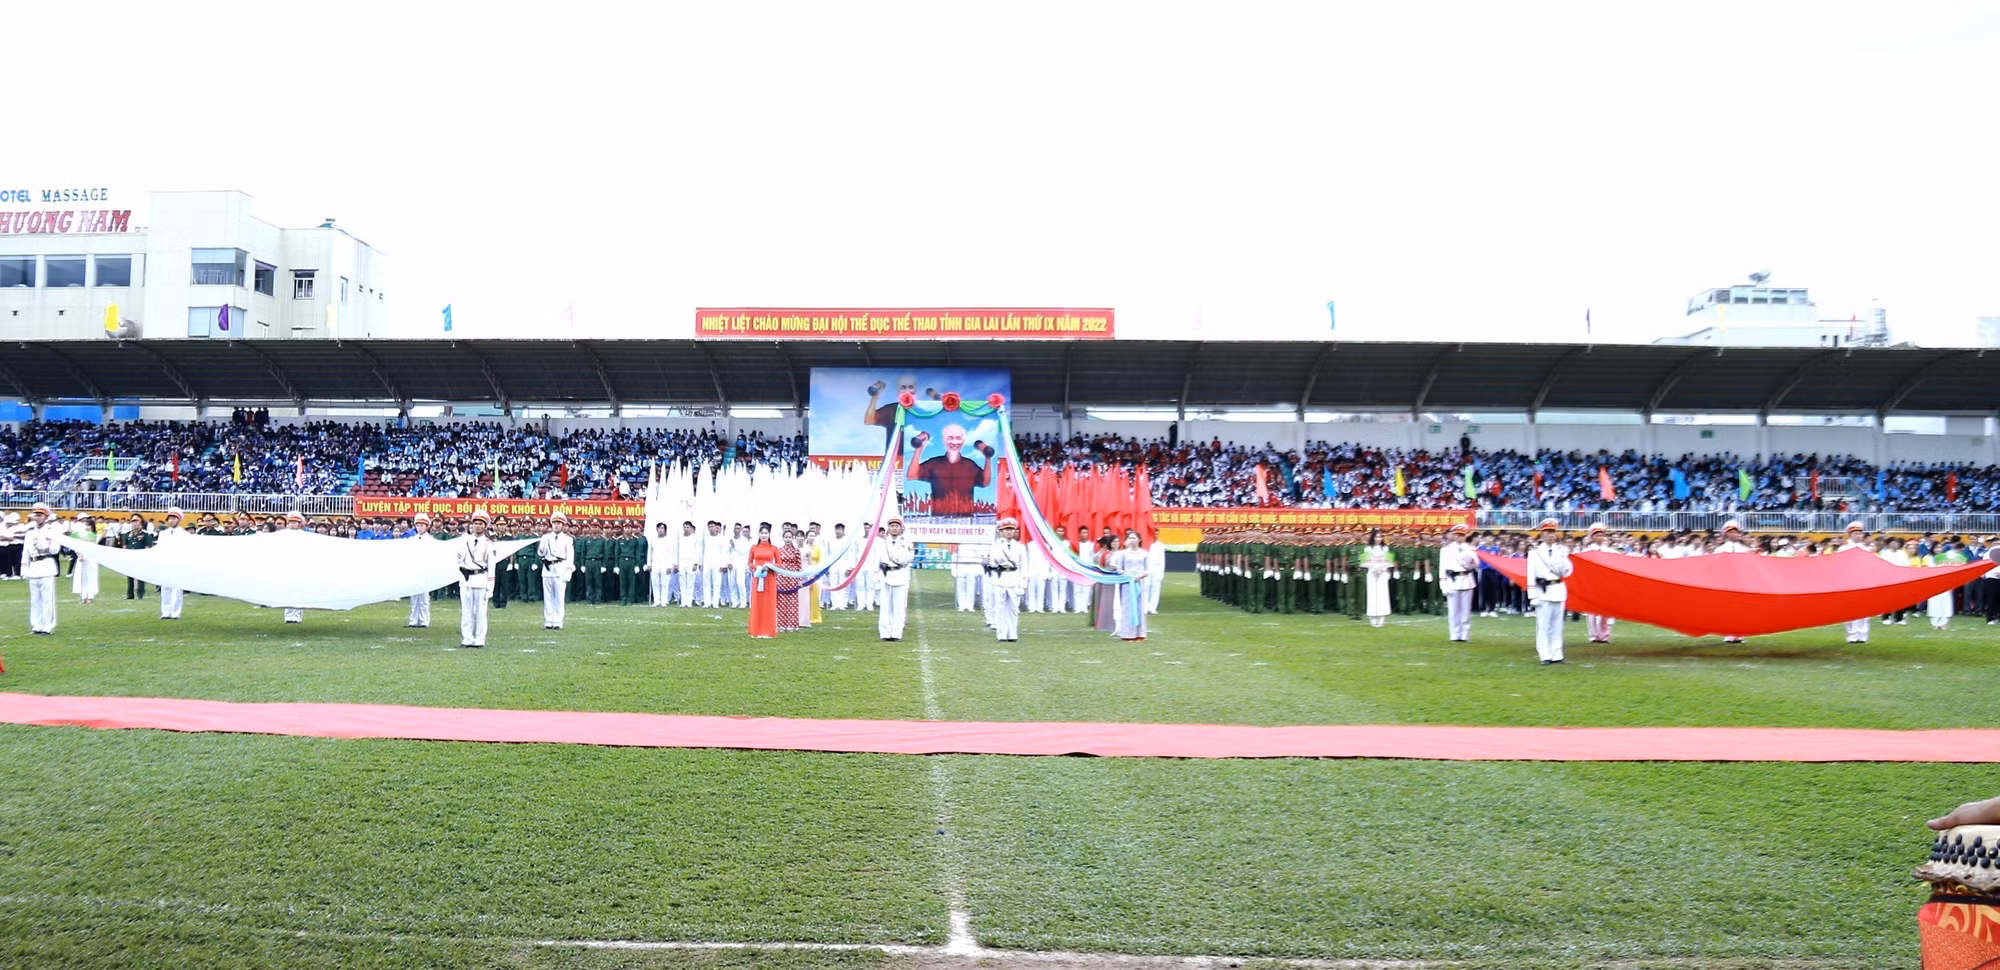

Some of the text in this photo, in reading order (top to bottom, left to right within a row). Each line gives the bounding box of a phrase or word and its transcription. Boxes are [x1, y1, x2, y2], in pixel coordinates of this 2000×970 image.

[42, 188, 108, 203] MASSAGE
[78, 210, 131, 233] NAM
[703, 314, 730, 334] NHIỆT
[732, 314, 750, 334] LIỆT
[754, 313, 778, 331] CHÀO
[781, 314, 810, 331] MỪNG
[813, 317, 829, 334] ĐẠI
[832, 314, 848, 334] HỘI
[851, 312, 868, 331] THỂ
[870, 317, 890, 334] DỤC
[892, 312, 911, 331] THỂ
[912, 317, 937, 331] THAO
[940, 312, 962, 331] TỈNH
[965, 317, 981, 331] GIA
[984, 317, 999, 331] LAI
[1023, 314, 1042, 331] THỨ
[1044, 317, 1055, 331] IX
[1057, 314, 1080, 331] NĂM
[1082, 317, 1106, 332] 2022
[394, 501, 411, 514] TẬP
[413, 500, 431, 513] THỂ
[490, 502, 509, 514] SỨC
[511, 502, 536, 515] KHỎE
[539, 503, 551, 515] LÀ
[575, 504, 601, 517] PHẬN
[604, 503, 623, 516] CỦA
